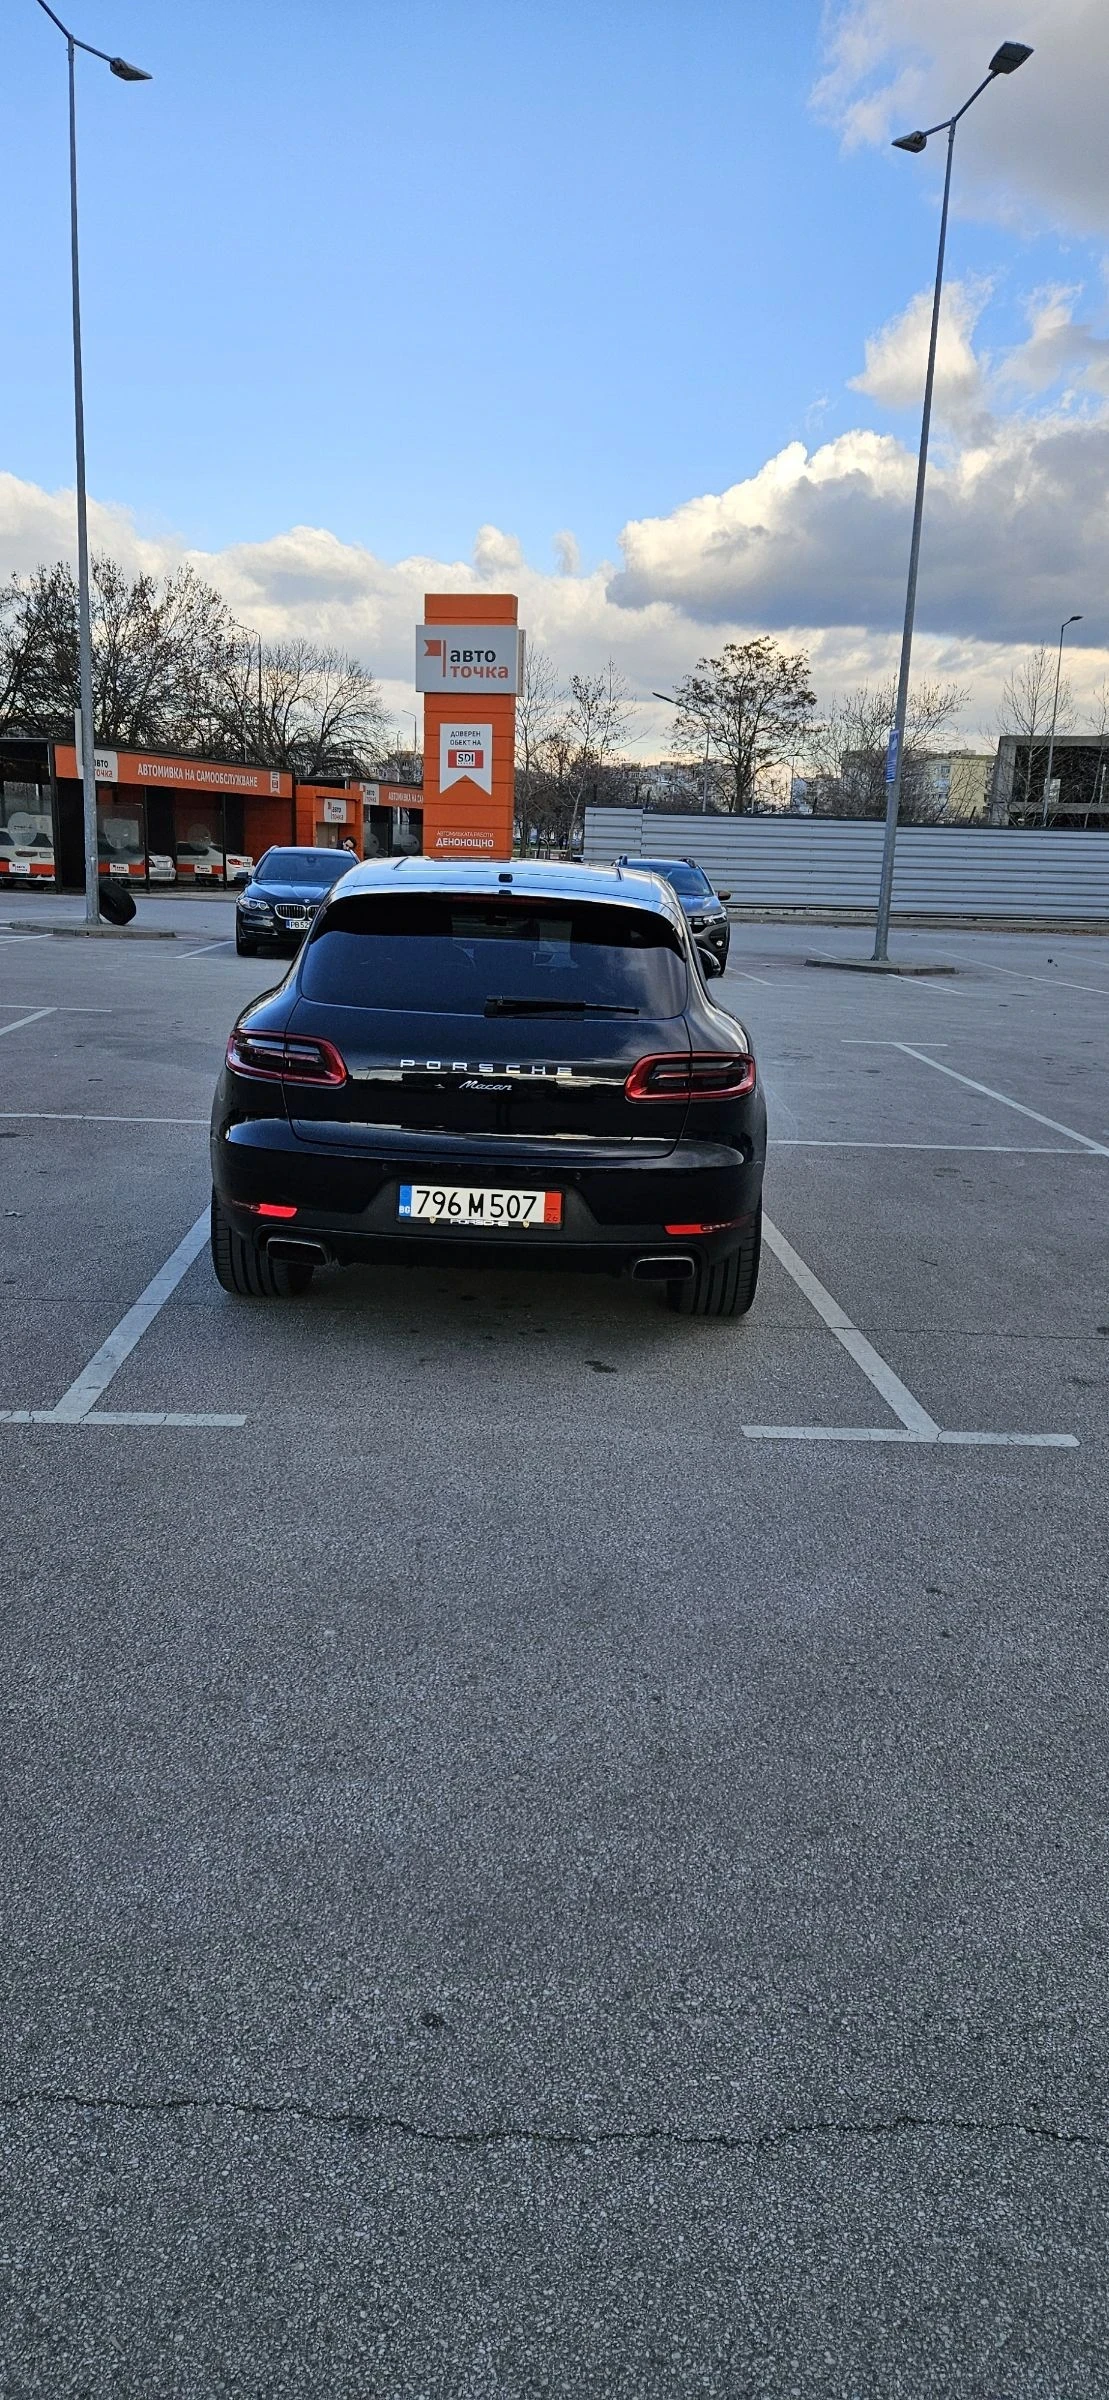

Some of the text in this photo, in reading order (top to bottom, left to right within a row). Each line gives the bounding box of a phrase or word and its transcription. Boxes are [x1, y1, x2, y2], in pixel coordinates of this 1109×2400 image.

[450, 650, 497, 662] авто
[450, 666, 509, 678] точка
[457, 753, 474, 763] SDI
[137, 763, 184, 779] АВТОМИВКА
[185, 770, 195, 781] НА
[196, 771, 258, 787] САМООБСЛУЖВАНЕ
[436, 837, 494, 848] ДЕНОНОЩНО
[400, 1059, 573, 1076] PORSCHE
[458, 1080, 513, 1091] Macan
[398, 1205, 411, 1214] BG
[450, 1218, 509, 1227] PORSCHE
